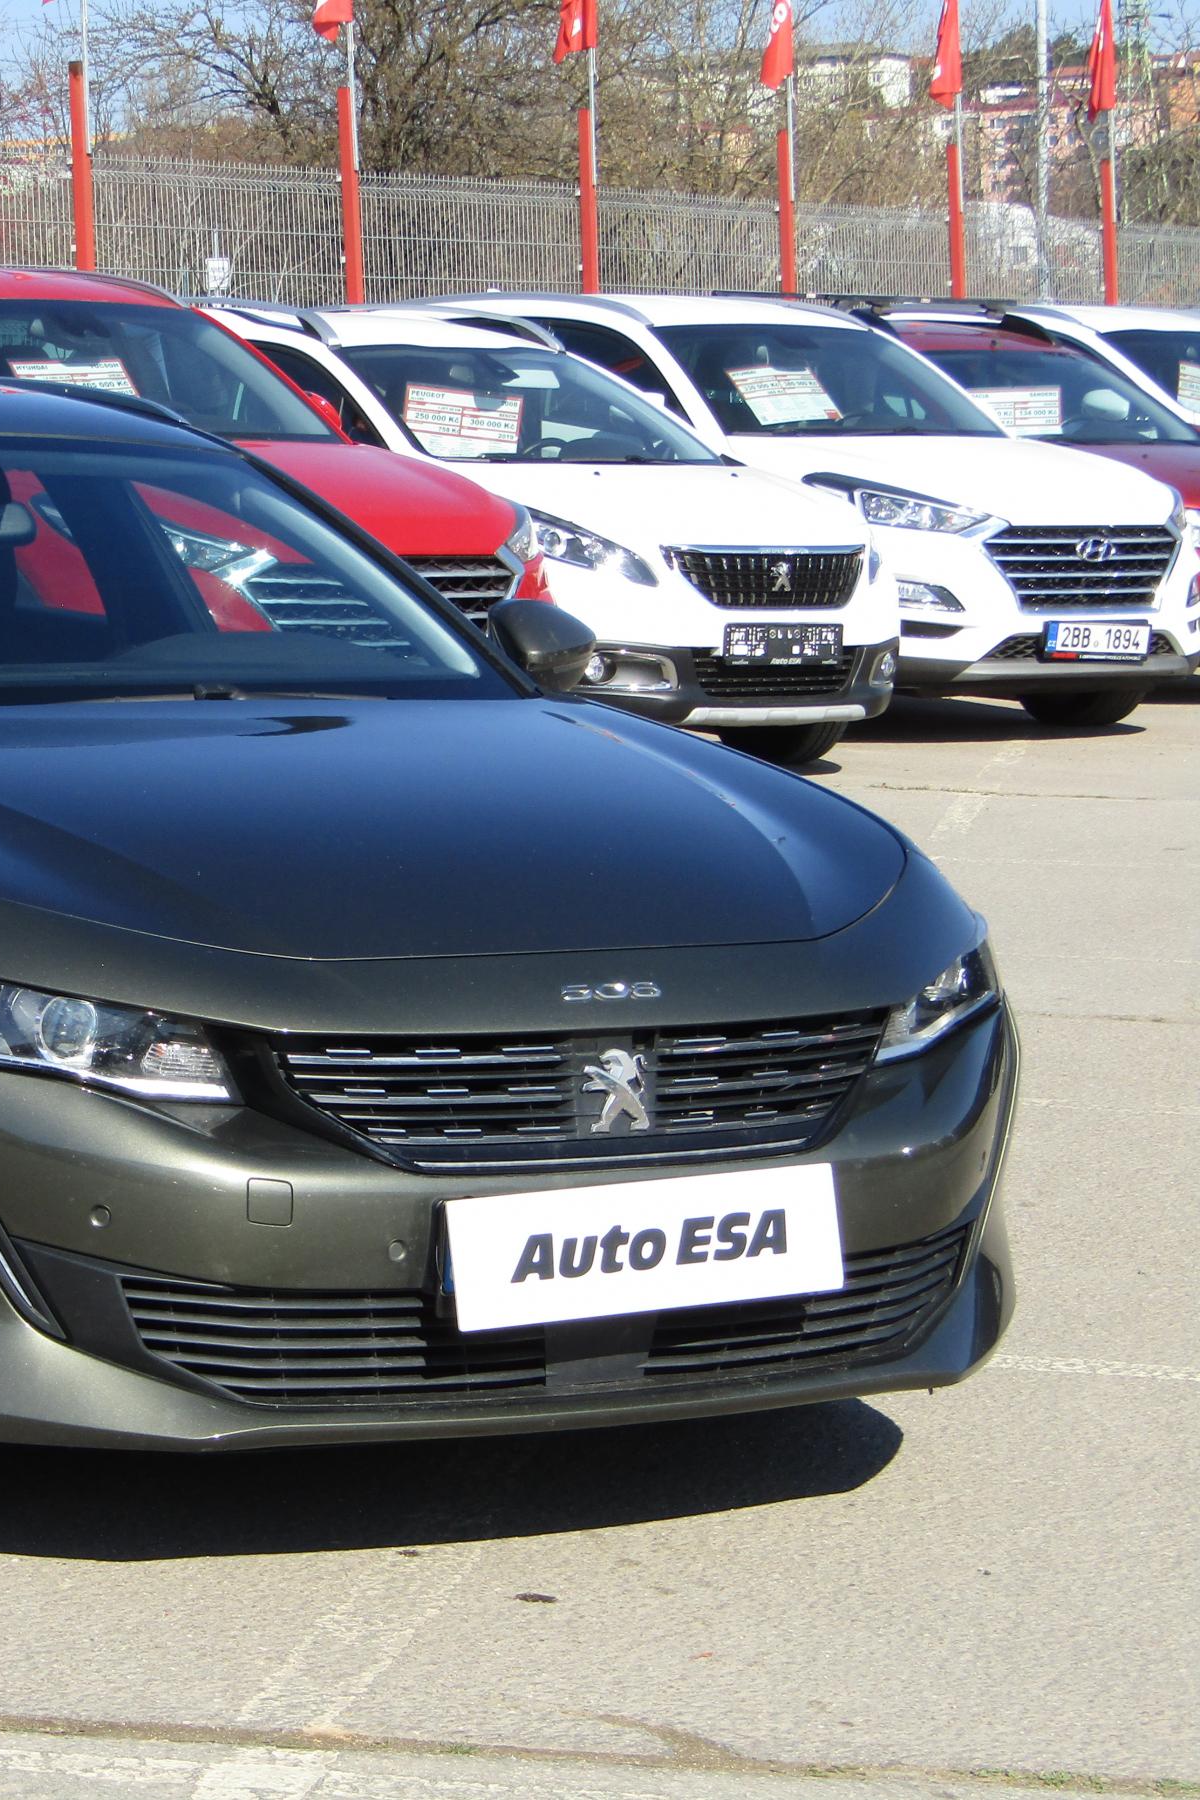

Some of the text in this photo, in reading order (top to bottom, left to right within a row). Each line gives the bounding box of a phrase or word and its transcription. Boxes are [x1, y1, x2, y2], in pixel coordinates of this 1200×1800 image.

[411, 390, 446, 400] PEUGEOT
[415, 412, 460, 424] 250 000 Kč
[470, 418, 515, 430] 300 000 Kč
[1060, 626, 1140, 650] 2BB 1894
[561, 981, 661, 1001] 508
[510, 1208, 788, 1284] Auto ESA
